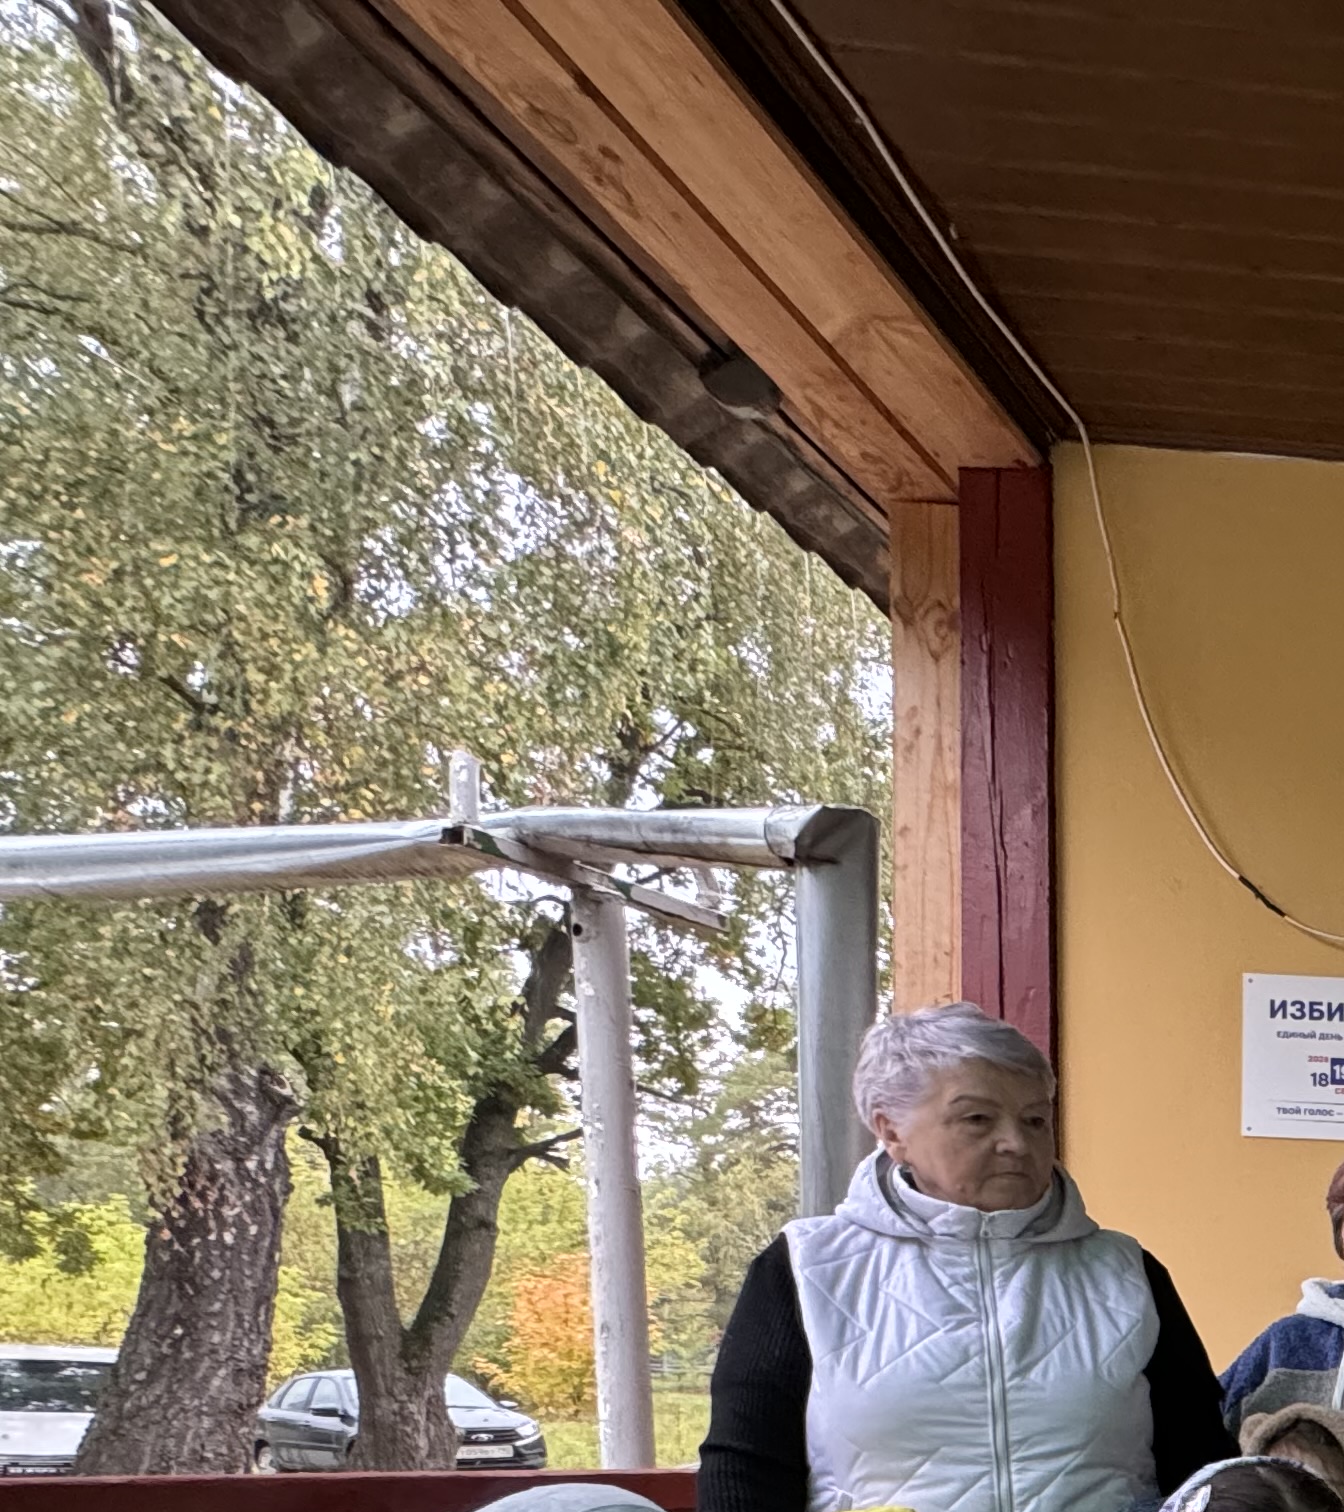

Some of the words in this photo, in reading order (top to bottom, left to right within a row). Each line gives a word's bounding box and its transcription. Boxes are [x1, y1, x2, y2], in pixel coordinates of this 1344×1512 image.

[1276, 1031, 1317, 1039] ЕДИНЫЙ
[1318, 1032, 1343, 1041] ДЕНЬ
[1310, 1072, 1330, 1088] 18
[1276, 1105, 1302, 1116] ТВОЙ
[1303, 1107, 1335, 1118] ГОЛОС
